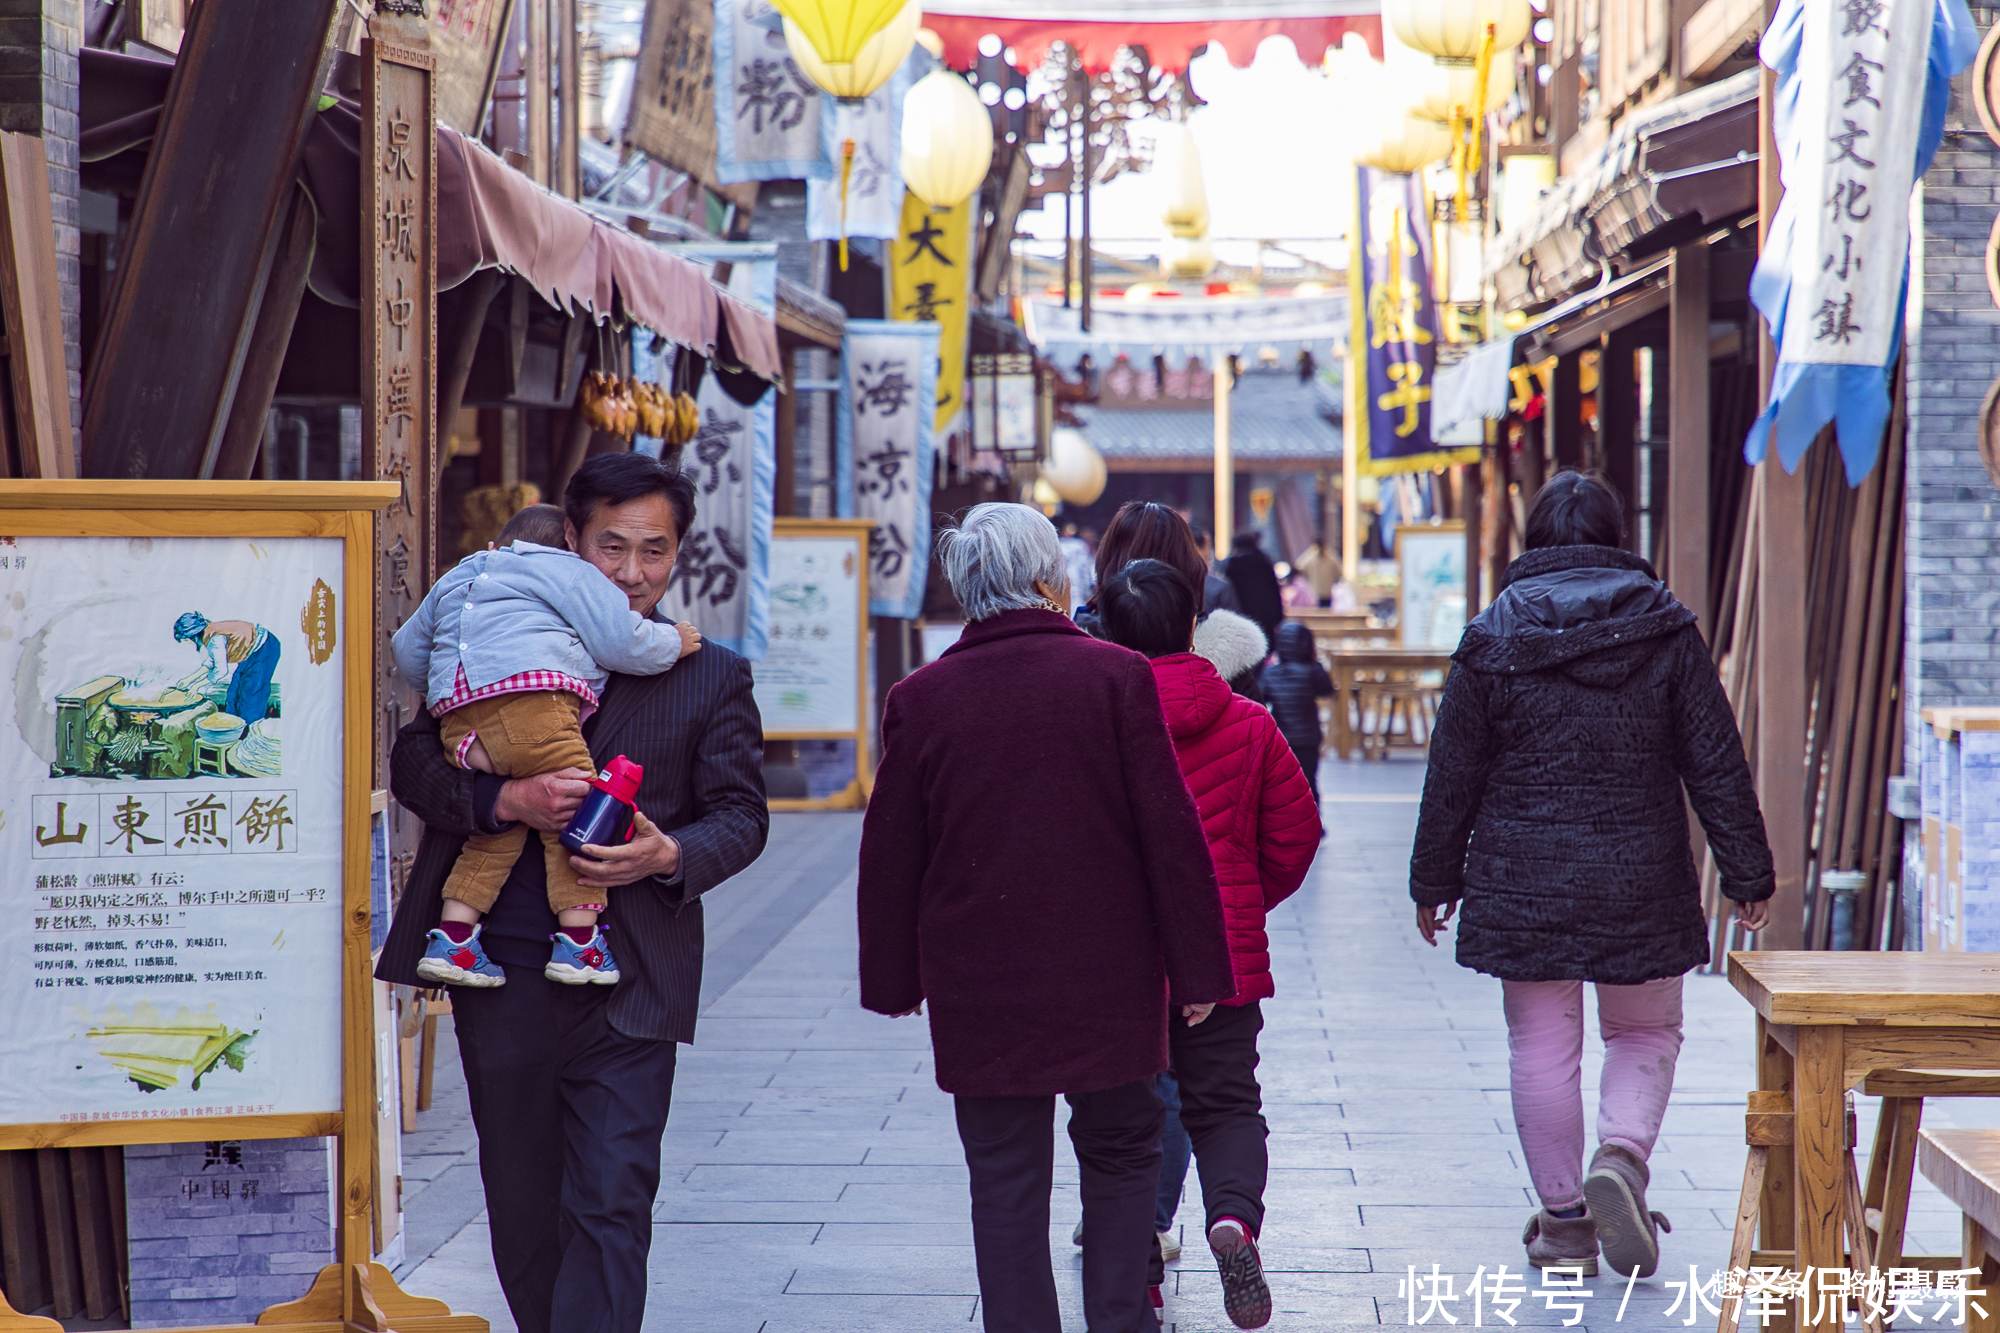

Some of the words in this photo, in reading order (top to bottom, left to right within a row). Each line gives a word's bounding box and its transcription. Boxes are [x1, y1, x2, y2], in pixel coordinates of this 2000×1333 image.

[316, 587, 327, 651] 舌尖上的中国
[36, 793, 294, 854] 山東煎餅
